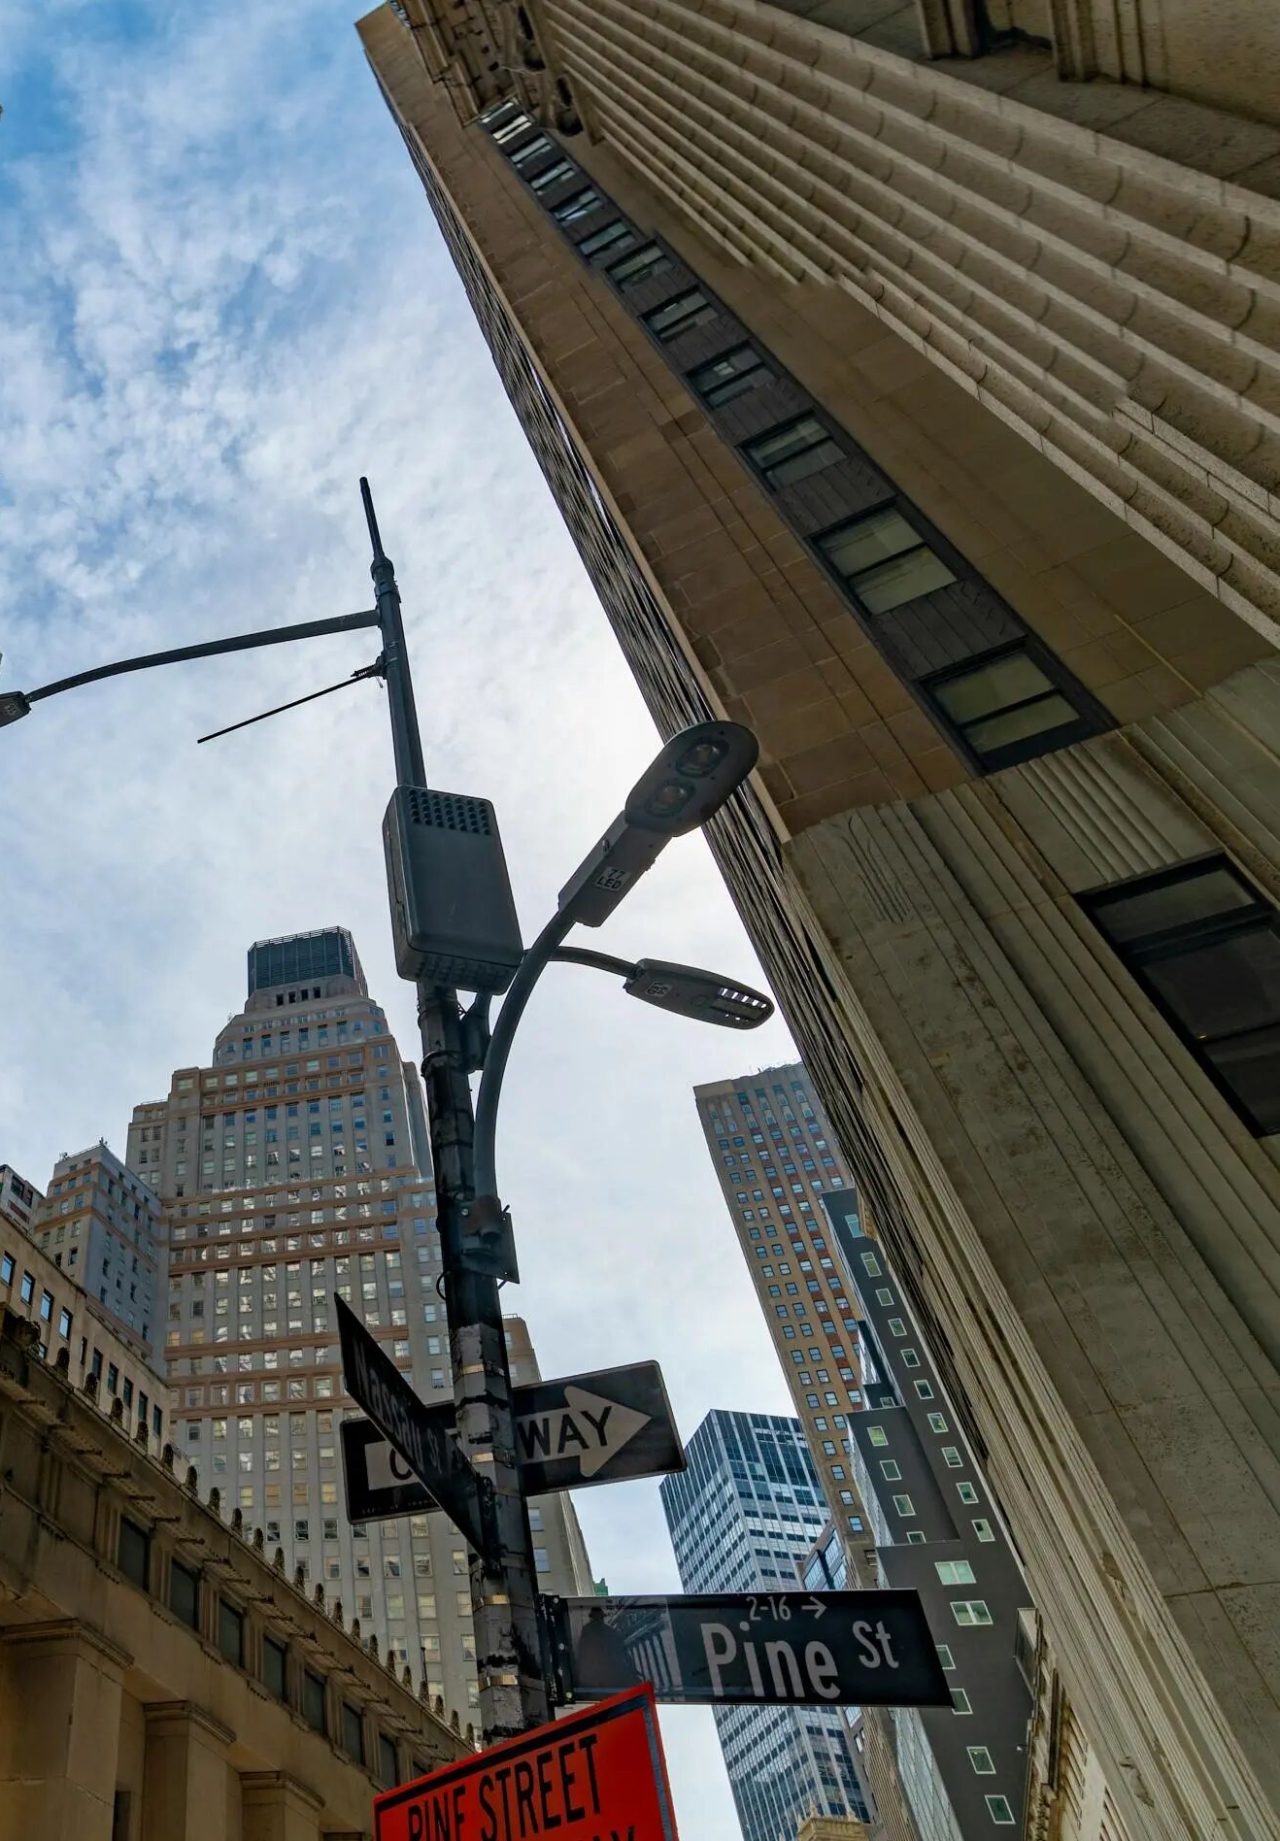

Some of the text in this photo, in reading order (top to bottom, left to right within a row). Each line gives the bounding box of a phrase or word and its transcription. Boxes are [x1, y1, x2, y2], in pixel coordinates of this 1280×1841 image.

[596, 876, 622, 889] LED
[352, 1334, 424, 1475] Nassau
[518, 1406, 612, 1458] WAY
[745, 1595, 791, 1621] 2-16
[700, 1620, 899, 1699] Pine St
[479, 1734, 601, 1841] STREET
